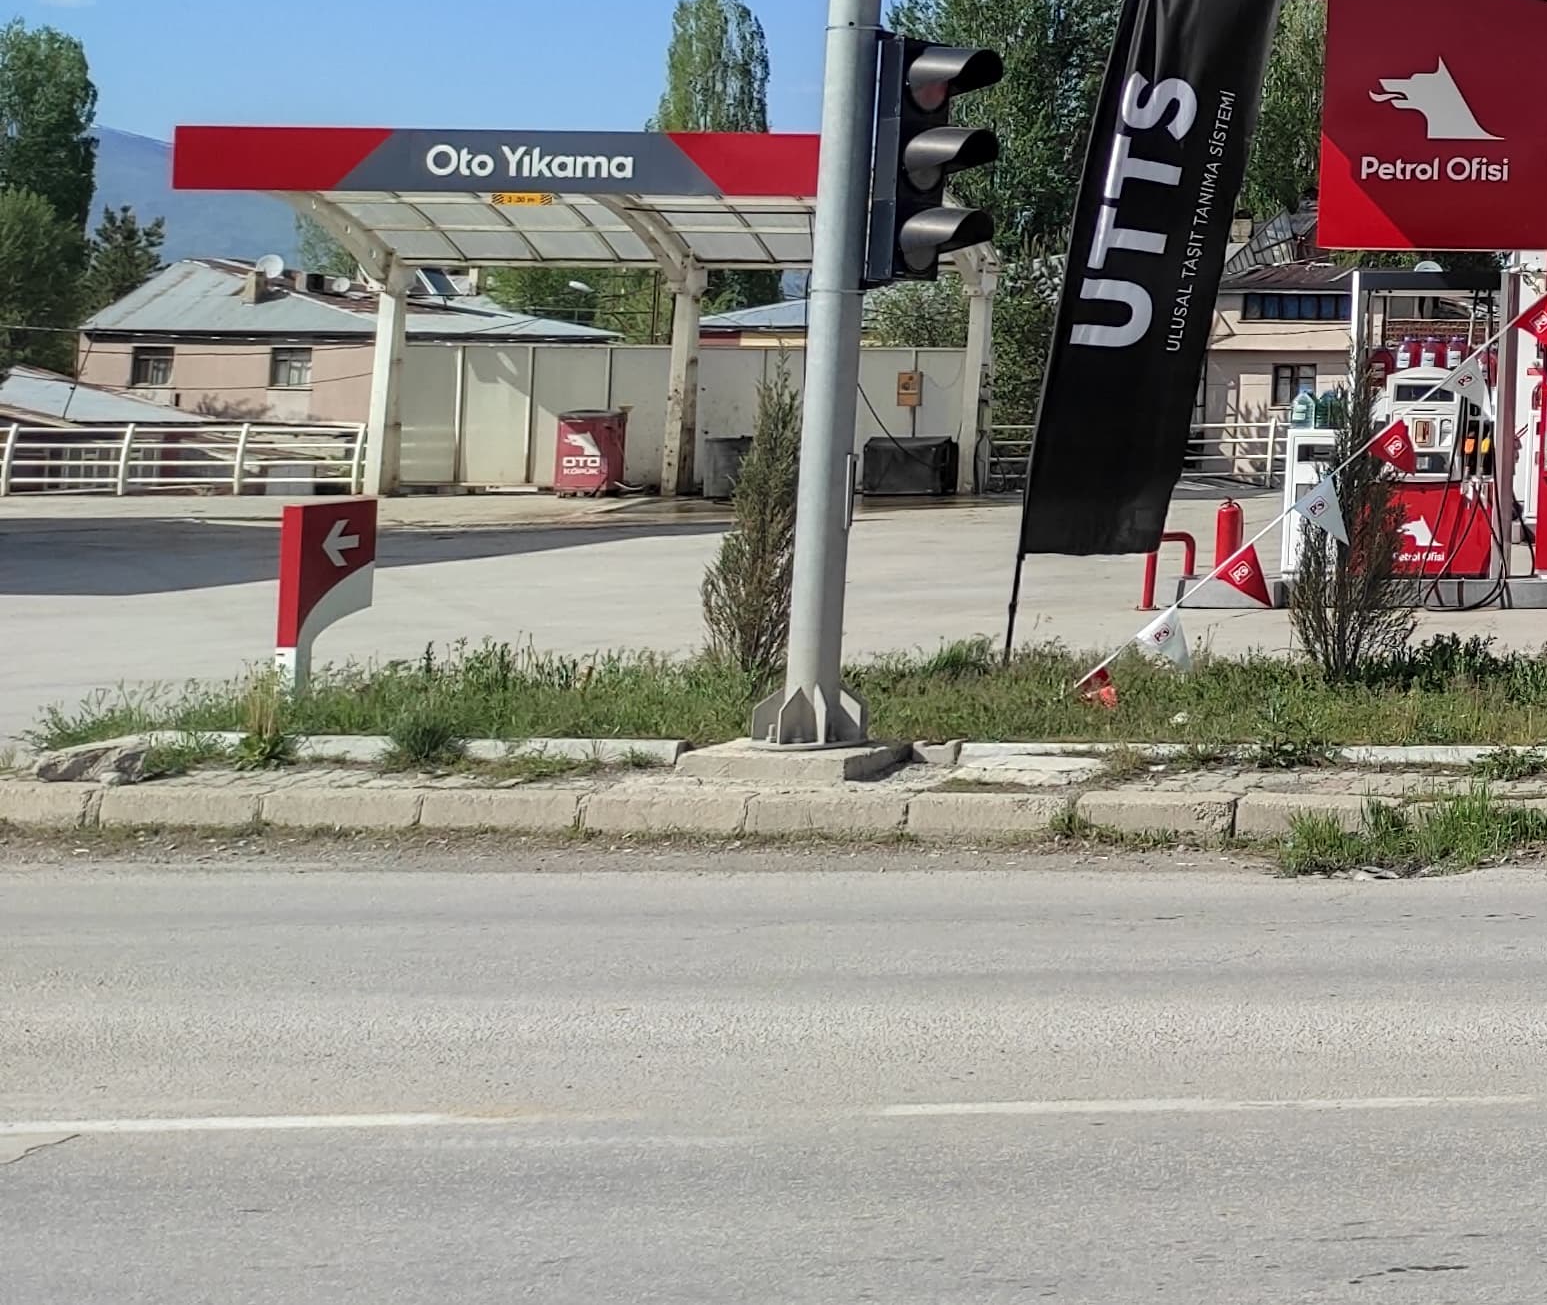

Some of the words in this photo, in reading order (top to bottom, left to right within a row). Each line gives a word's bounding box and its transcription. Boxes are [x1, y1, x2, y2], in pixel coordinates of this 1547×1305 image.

[426, 144, 495, 177] Oto
[501, 145, 634, 179] Yıkama
[1360, 156, 1440, 181] Petrol
[1446, 156, 1509, 182] Ofisi
[1069, 70, 1198, 348] UTTS
[1166, 284, 1193, 352] ULUSAL
[1180, 231, 1206, 279] TAŞIT
[1193, 162, 1222, 226] TANIMA
[1209, 90, 1237, 157] SİSTEMİ
[562, 456, 601, 467] OTO
